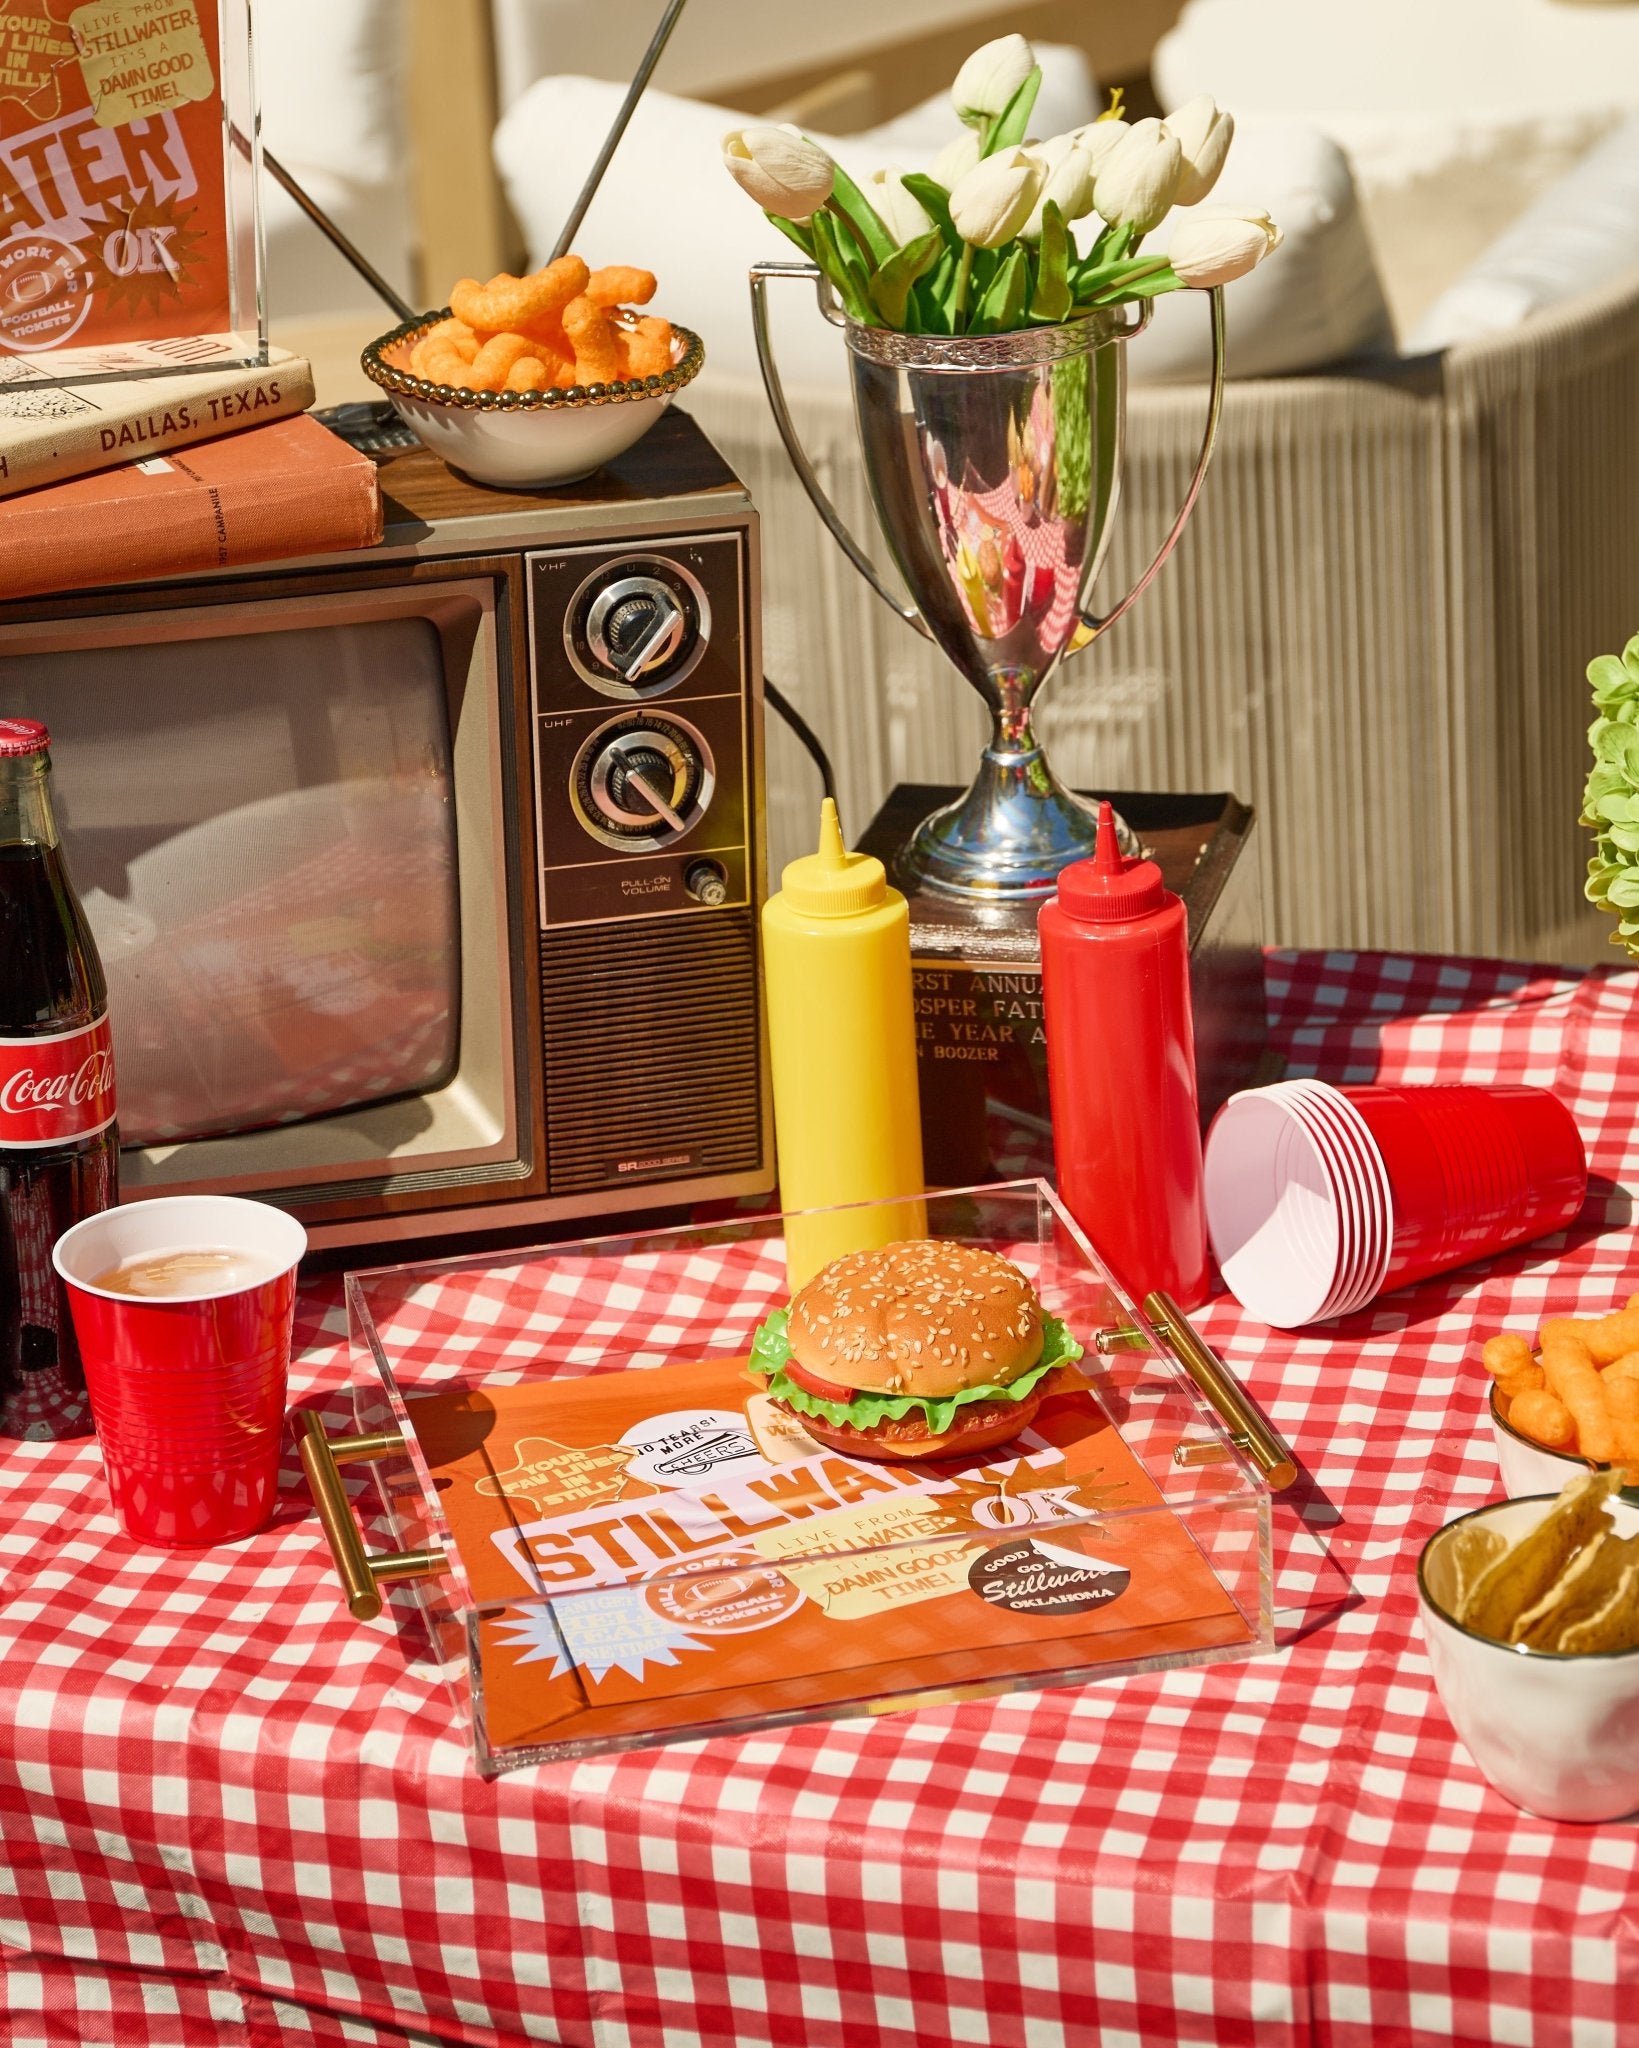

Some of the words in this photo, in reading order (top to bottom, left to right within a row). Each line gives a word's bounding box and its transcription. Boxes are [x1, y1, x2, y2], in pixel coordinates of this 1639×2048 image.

[83, 12, 121, 33] LIVE
[134, 0, 174, 17] FROM
[11, 33, 75, 56] LIVES
[82, 9, 194, 59] STILLWATER
[6, 51, 29, 70] IN
[110, 47, 147, 68] IT'S
[160, 42, 168, 53] A
[100, 66, 147, 96] DAMN
[147, 52, 194, 80] GOOD
[127, 81, 179, 109] TIME!
[0, 246, 53, 269] WORK
[103, 226, 179, 277] OK
[1, 300, 75, 328] FOOTBALL
[11, 313, 71, 338] TICKETS
[100, 406, 198, 451] DALLAS,
[208, 382, 282, 421] TEXAS
[209, 488, 228, 542] CAMPANILE
[539, 562, 567, 571] VHF
[653, 567, 661, 575] 2
[673, 582, 681, 591] 3
[544, 718, 574, 728] UHF
[621, 876, 671, 888] PULL-ON
[622, 884, 671, 896] VOLUME
[912, 972, 952, 991] RST
[969, 975, 1043, 995] ANNU
[949, 1023, 1015, 1042] YEAR
[934, 1045, 1000, 1061] BOOZER
[0, 1042, 112, 1114] Coca-Cola
[618, 1161, 637, 1172] SR
[658, 1416, 718, 1446] TEARS!
[659, 1431, 704, 1455] MORE
[520, 1451, 590, 1476] YOUR
[671, 1440, 747, 1470] CHEERS
[501, 1472, 550, 1494] FAV
[551, 1452, 629, 1479] LIVES
[560, 1474, 592, 1490] IN
[542, 1473, 624, 1506] STILLY
[971, 1485, 1099, 1530] OK
[777, 1529, 837, 1550] LIVE
[854, 1508, 915, 1530] FROM
[778, 1514, 947, 1571] STILLWATER
[823, 1567, 895, 1595] DAMN
[896, 1550, 968, 1576] GOOD
[984, 1549, 1030, 1573] GOOD
[1016, 1563, 1044, 1574] GO
[872, 1572, 956, 1600] TIME!
[1010, 1587, 1115, 1609] OKLAHOMA
[684, 1592, 786, 1621] FOOTBALL
[702, 1601, 784, 1627] TICKETS
